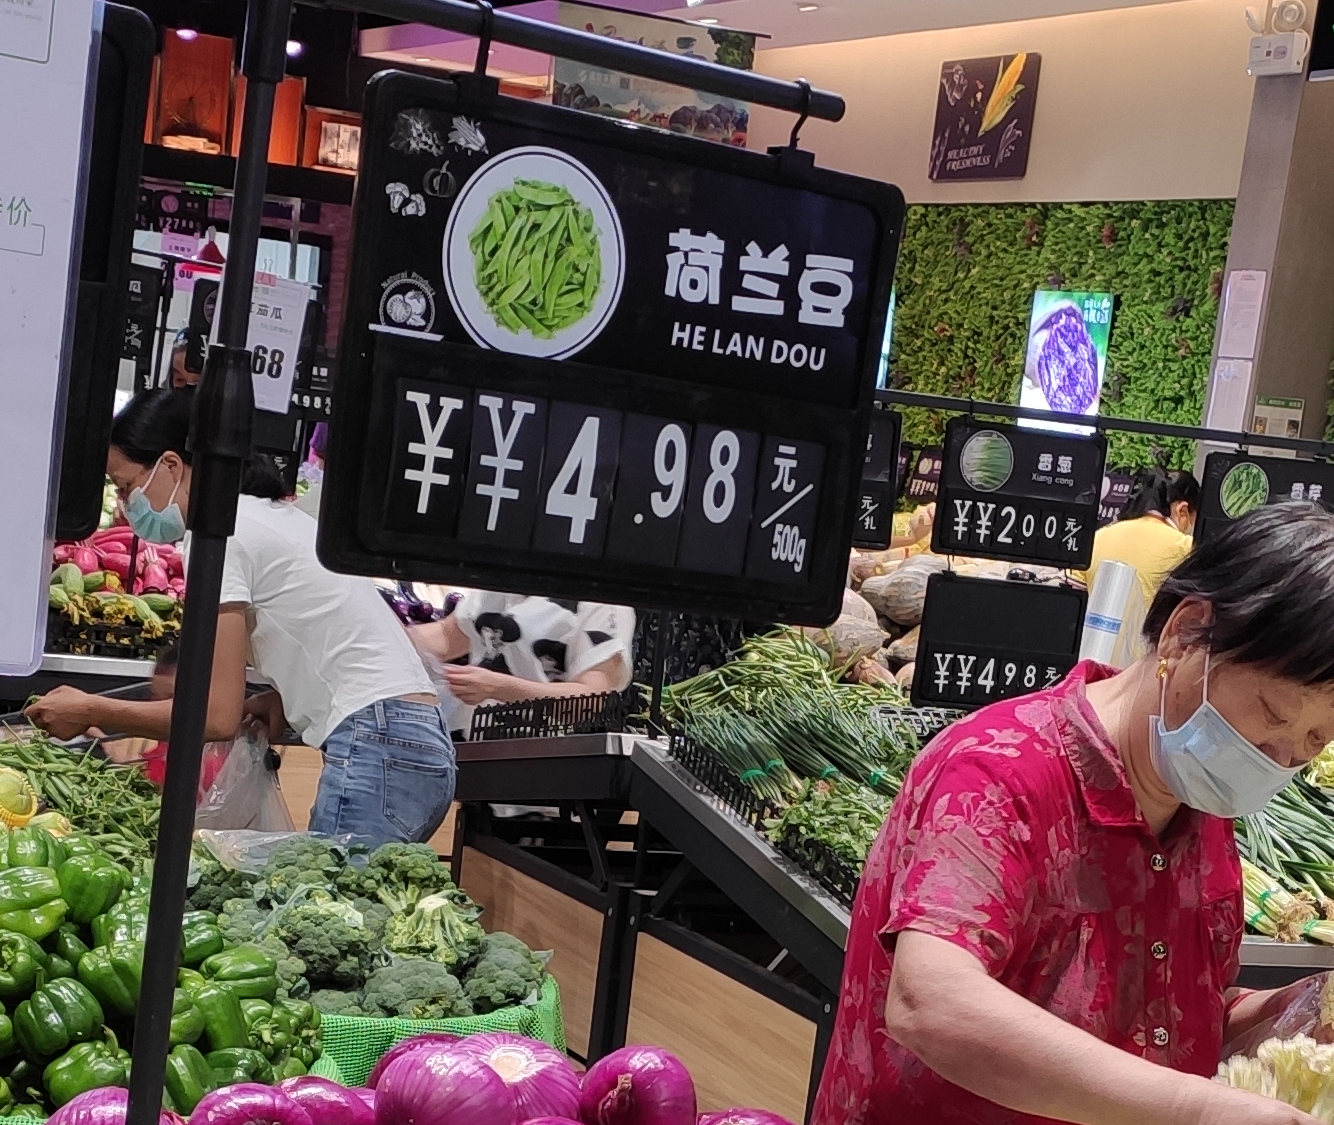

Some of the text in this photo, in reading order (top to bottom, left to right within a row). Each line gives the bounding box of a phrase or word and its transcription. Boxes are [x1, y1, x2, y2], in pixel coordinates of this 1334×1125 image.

[664, 228, 854, 328] 荷兰豆
[671, 322, 827, 372] HE LAN DOU
[404, 390, 814, 573] ¥¥4.98 元/500g
[1031, 472, 1075, 487] Xiang cong
[1037, 453, 1073, 474] 香葱
[953, 499, 1058, 546] ¥¥2.00
[934, 653, 1037, 695] ¥¥4.98
